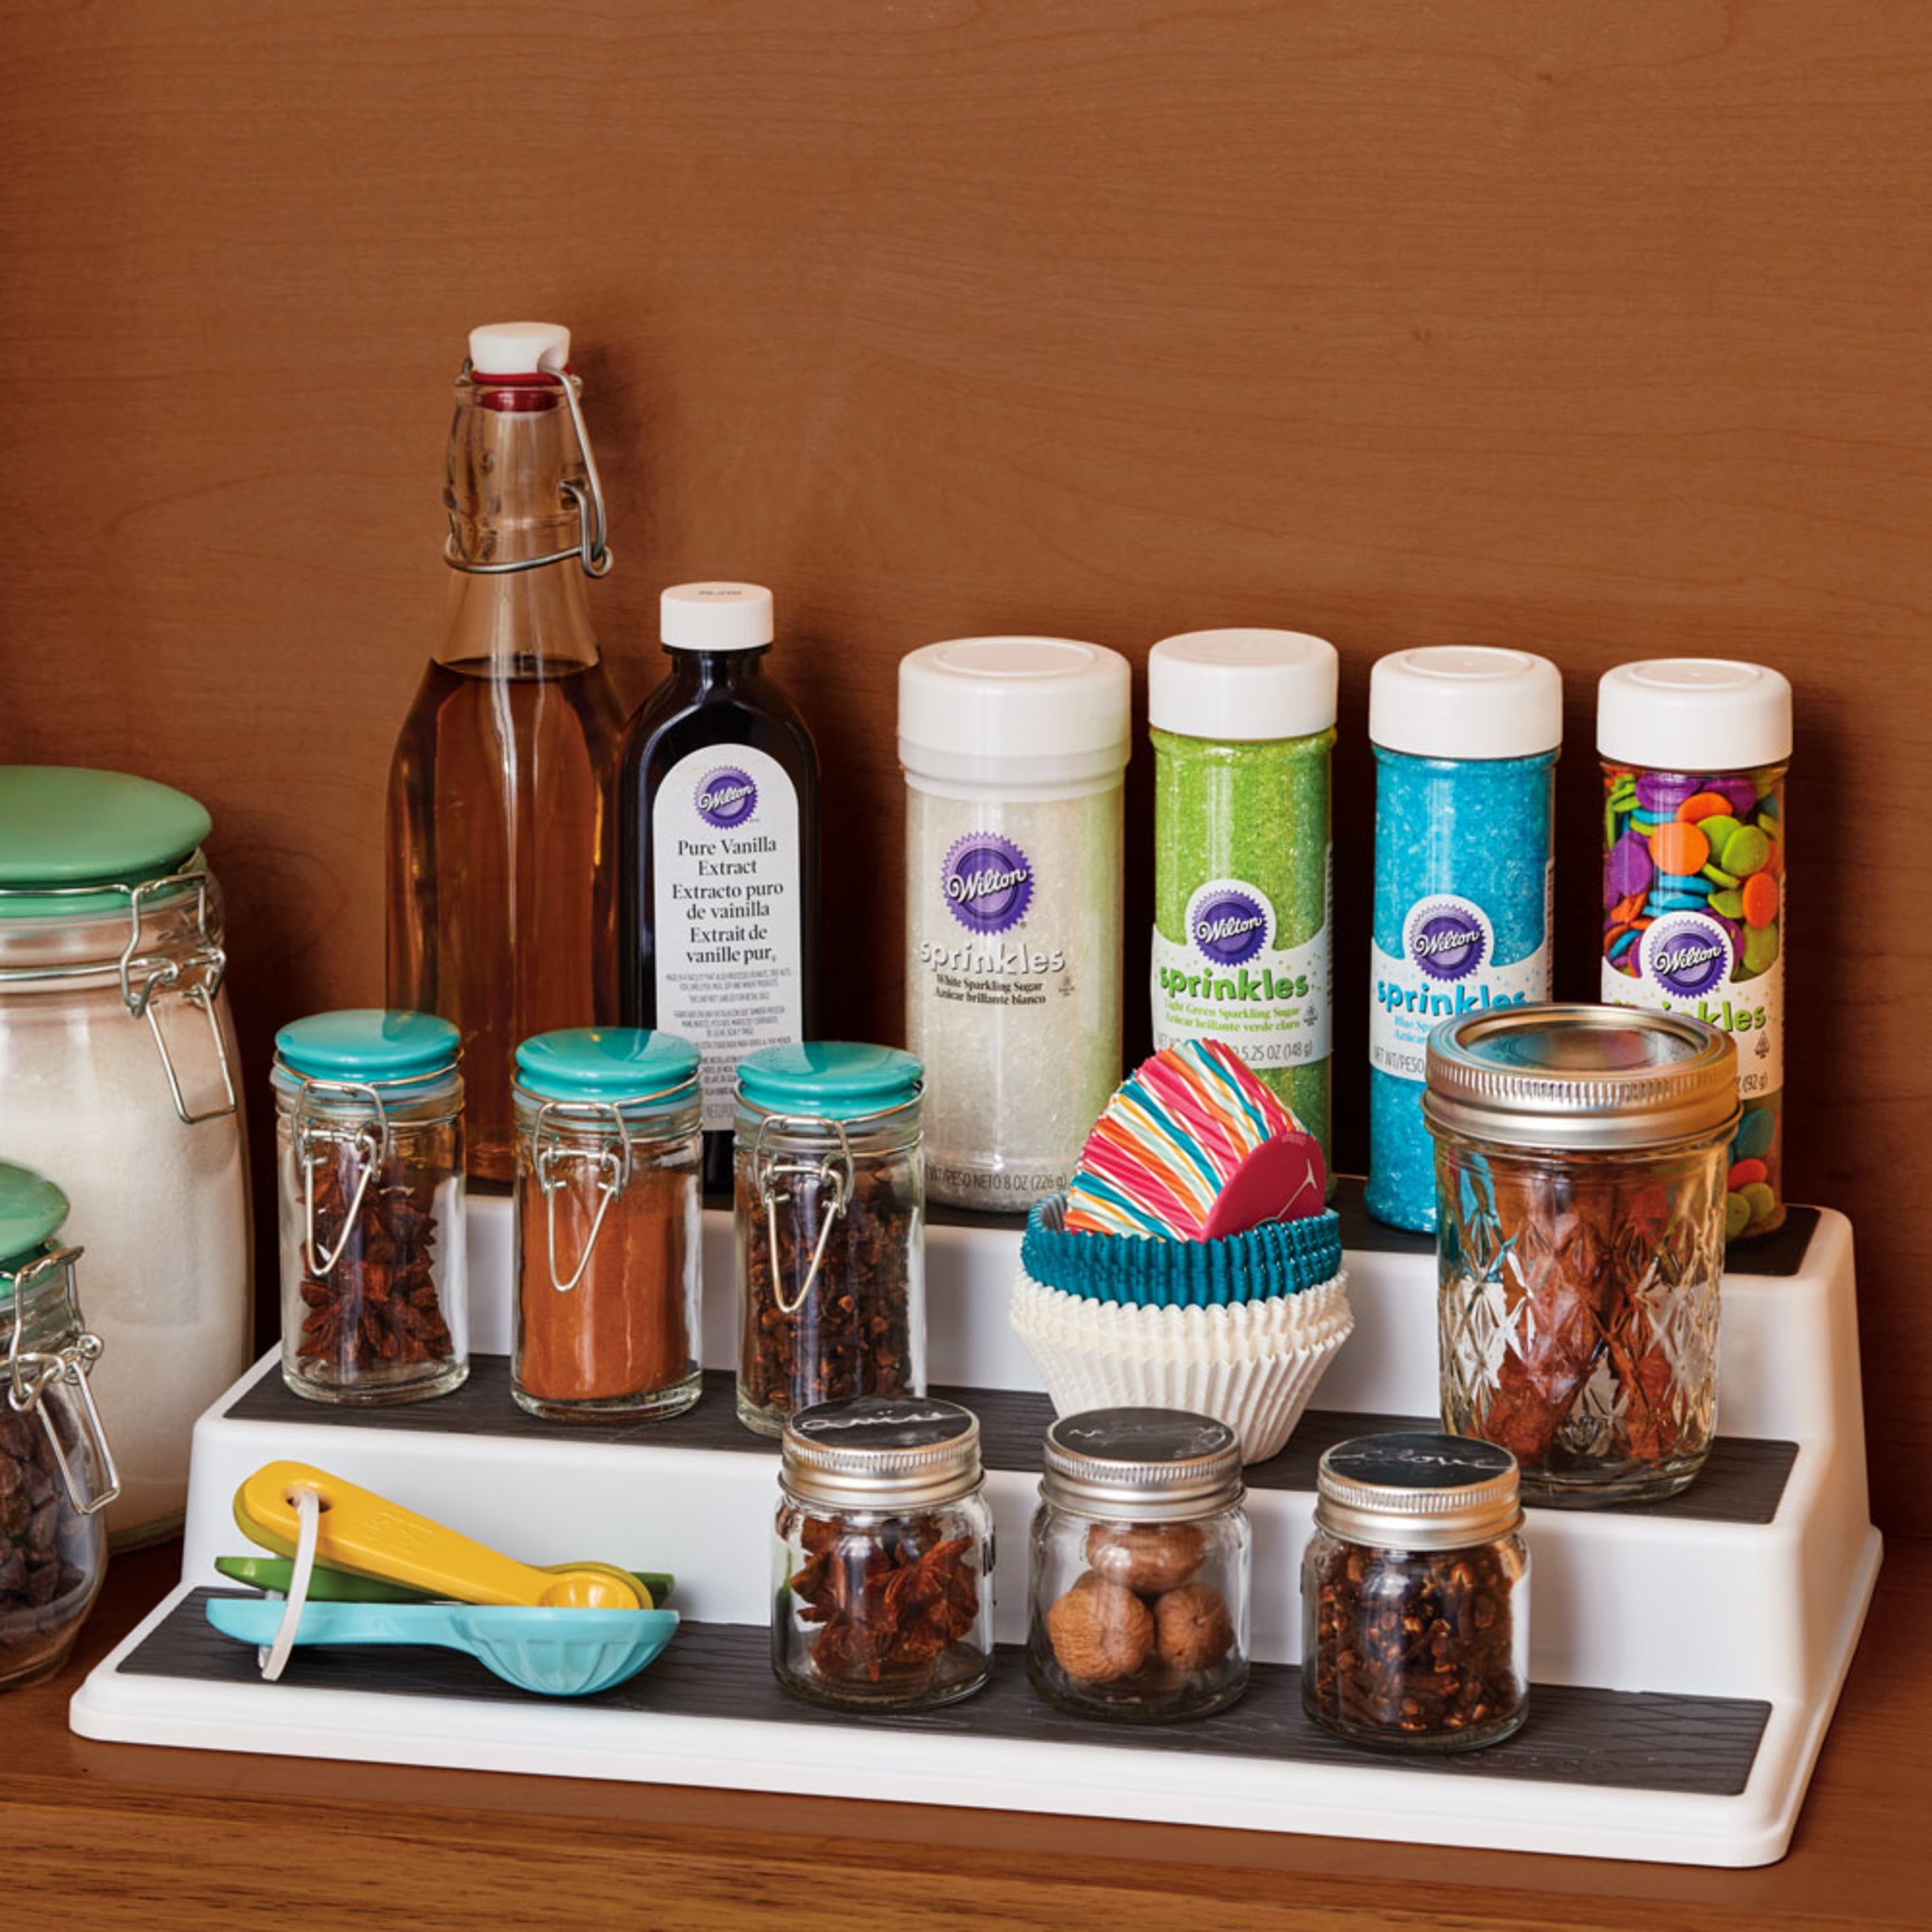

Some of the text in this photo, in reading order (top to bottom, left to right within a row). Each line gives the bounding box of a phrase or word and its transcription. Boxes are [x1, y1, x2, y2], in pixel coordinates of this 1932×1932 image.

[699, 785, 755, 813] Wilton
[677, 836, 777, 857] Pure Vanilla
[698, 859, 757, 876] Extract
[672, 882, 784, 903] Extracto puro
[947, 869, 1028, 904] Wilton
[687, 902, 770, 920] de vainilla
[690, 923, 768, 944] Extrait de
[1196, 917, 1263, 943] Wilton
[686, 946, 741, 963] vanille
[1416, 931, 1480, 957] Wilton
[920, 942, 1066, 975] sprinkles
[1655, 946, 1721, 976] Wilton
[936, 973, 962, 987] White
[963, 977, 1011, 992] Sparkling
[1013, 981, 1043, 994] Sugar
[1159, 966, 1309, 1001] sprinkles
[1186, 1003, 1217, 1017] Green
[1219, 1009, 1271, 1020] Sparkling
[1273, 1008, 1300, 1018] Sugar
[1196, 1018, 1240, 1031] brillante
[1244, 1023, 1273, 1032] verde
[1275, 1019, 1301, 1030] claro
[1242, 1045, 1265, 1061] 5.25
[1267, 1045, 1282, 1061] OZ
[973, 1173, 1001, 1191] NETO
[1003, 1174, 1012, 1190] 8
[1014, 1174, 1029, 1191] OZ
[1031, 1174, 1054, 1192] (226
